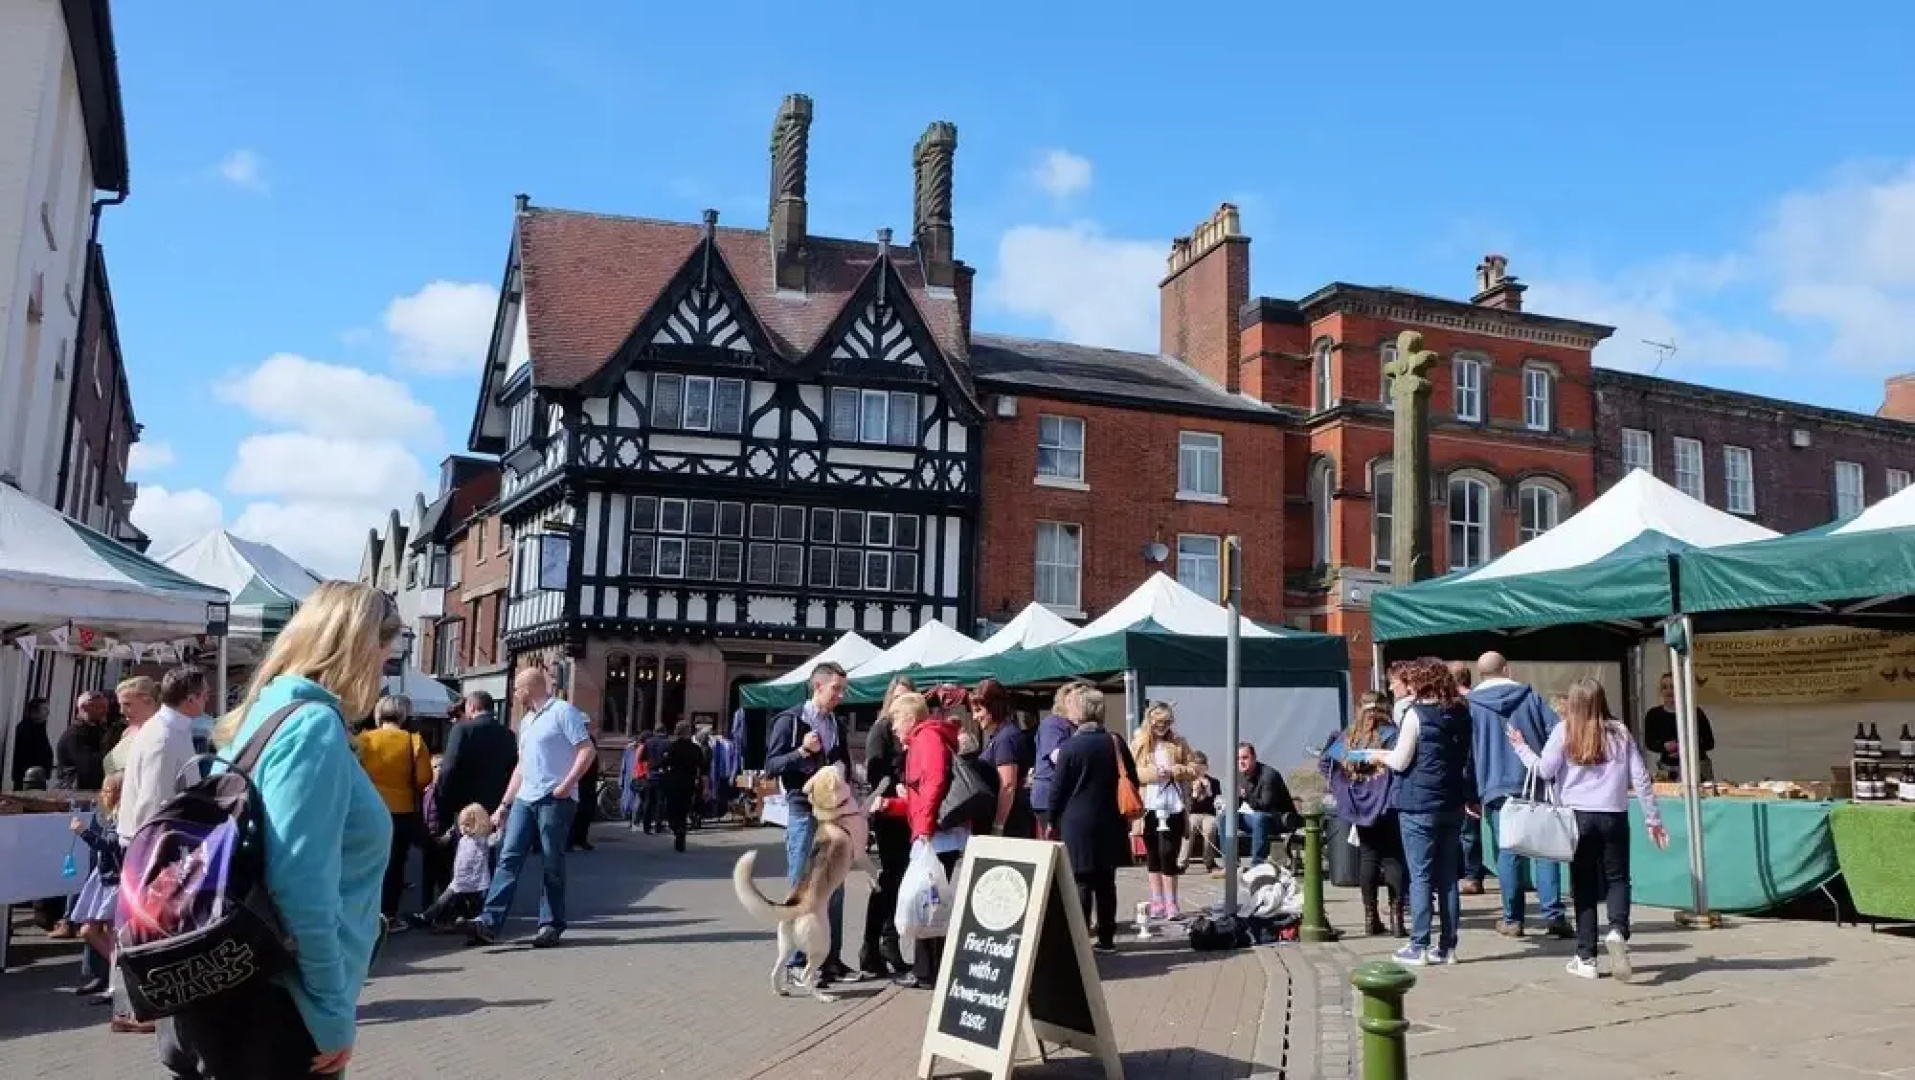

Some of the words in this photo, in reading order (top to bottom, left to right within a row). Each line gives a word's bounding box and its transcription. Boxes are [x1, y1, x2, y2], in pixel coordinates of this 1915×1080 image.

[1797, 632, 1871, 646] SAVOURY
[964, 932, 985, 952] Fine
[984, 934, 1020, 958] Foods
[145, 939, 253, 988] STAR
[968, 961, 990, 979] with
[990, 968, 1000, 981] a
[138, 957, 254, 1011] WARS
[959, 1010, 986, 1031] taste
